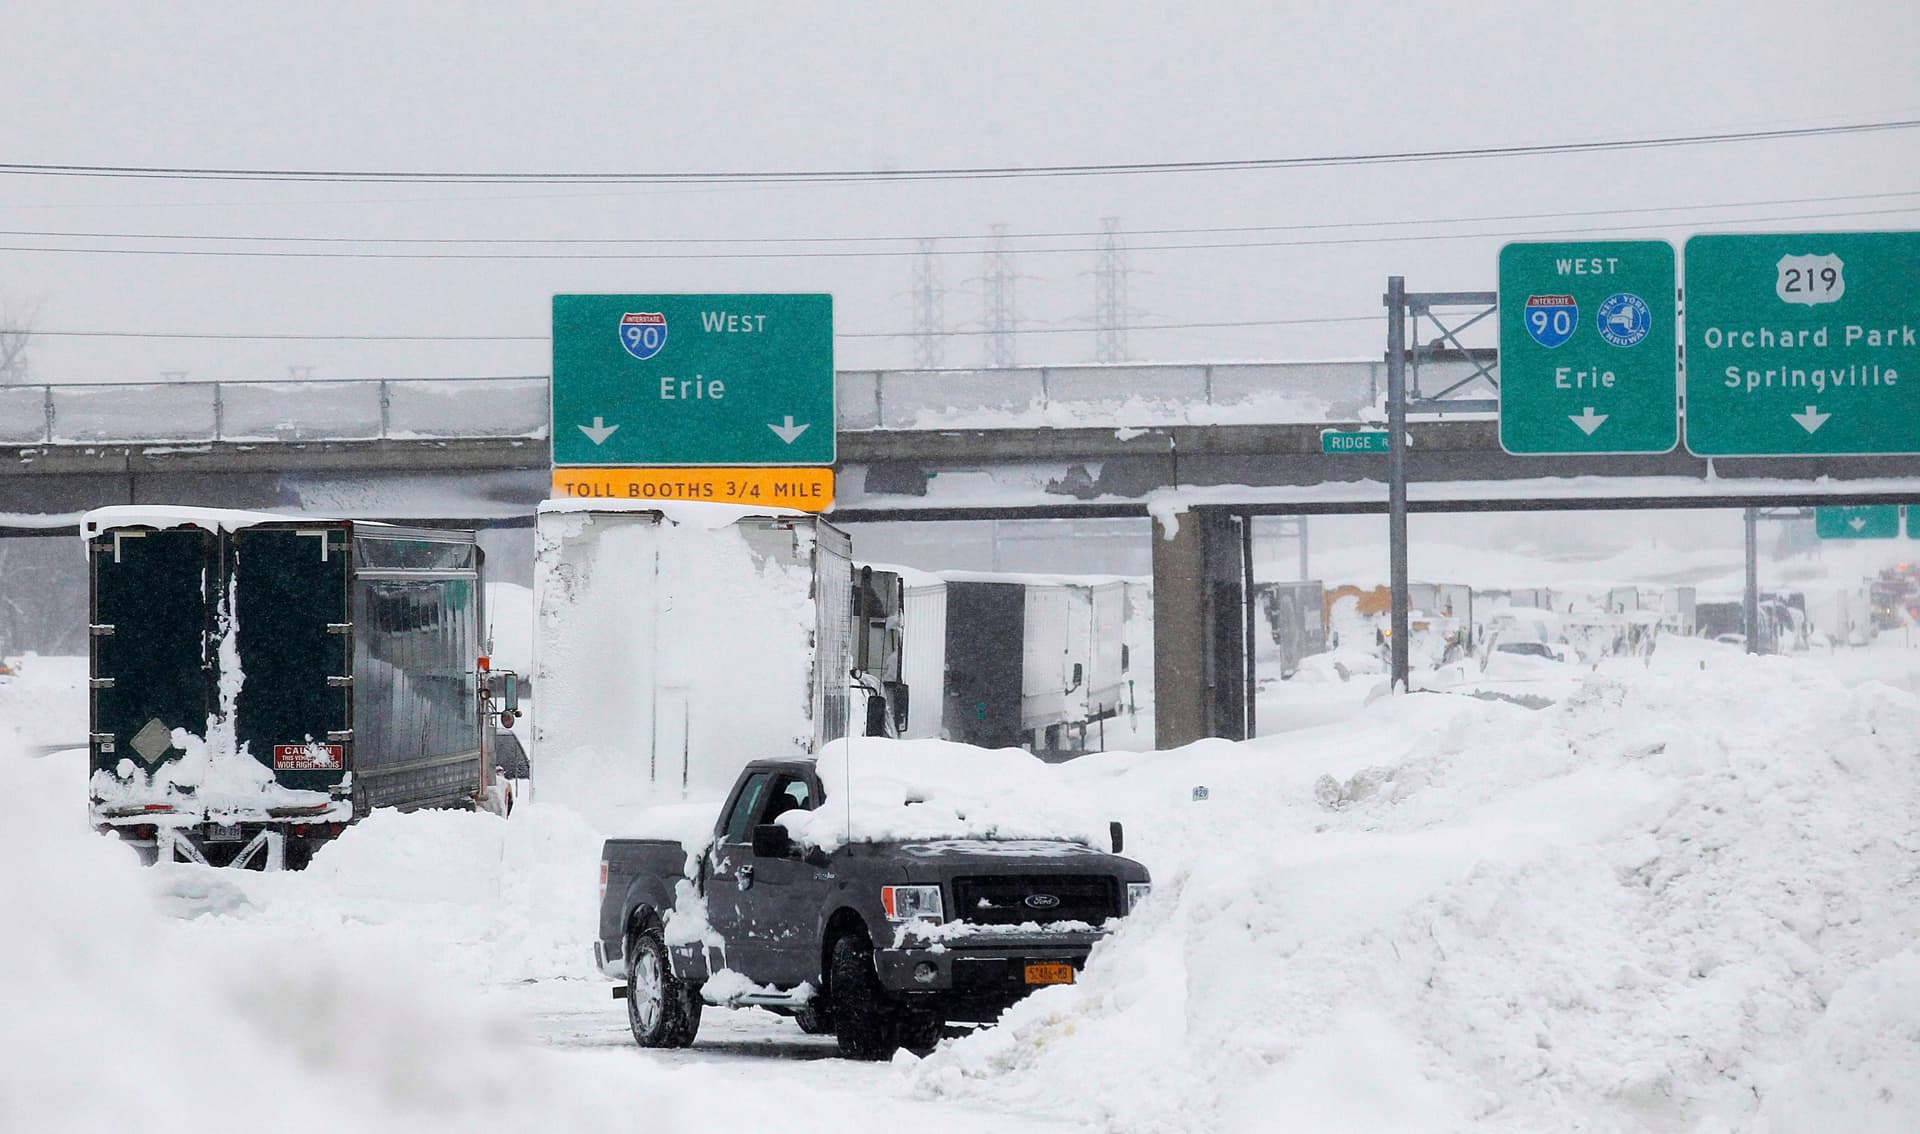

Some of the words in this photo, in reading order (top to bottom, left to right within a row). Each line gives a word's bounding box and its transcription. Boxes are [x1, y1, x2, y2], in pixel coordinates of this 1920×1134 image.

[1556, 258, 1618, 275] WEST
[1784, 267, 1837, 293] 219
[1532, 297, 1570, 306] INTERSTATE
[1600, 296, 1618, 316] NEW
[1623, 295, 1647, 315] YORK
[626, 315, 661, 323] INTERSTATE
[701, 311, 767, 333] WEST
[1531, 310, 1571, 336] 90
[626, 327, 660, 349] 90
[1601, 328, 1647, 346] THRUWAY
[1704, 326, 1828, 349] Orchard
[1845, 325, 1917, 347] Park
[660, 374, 726, 400] Erie
[1555, 366, 1616, 389] Erie
[1724, 365, 1899, 394] Springville
[1332, 436, 1371, 449] RIDGE
[565, 483, 616, 497] TOLL
[629, 482, 714, 498] BOOTHS
[726, 480, 761, 499] 3/4
[774, 482, 823, 497] MILE
